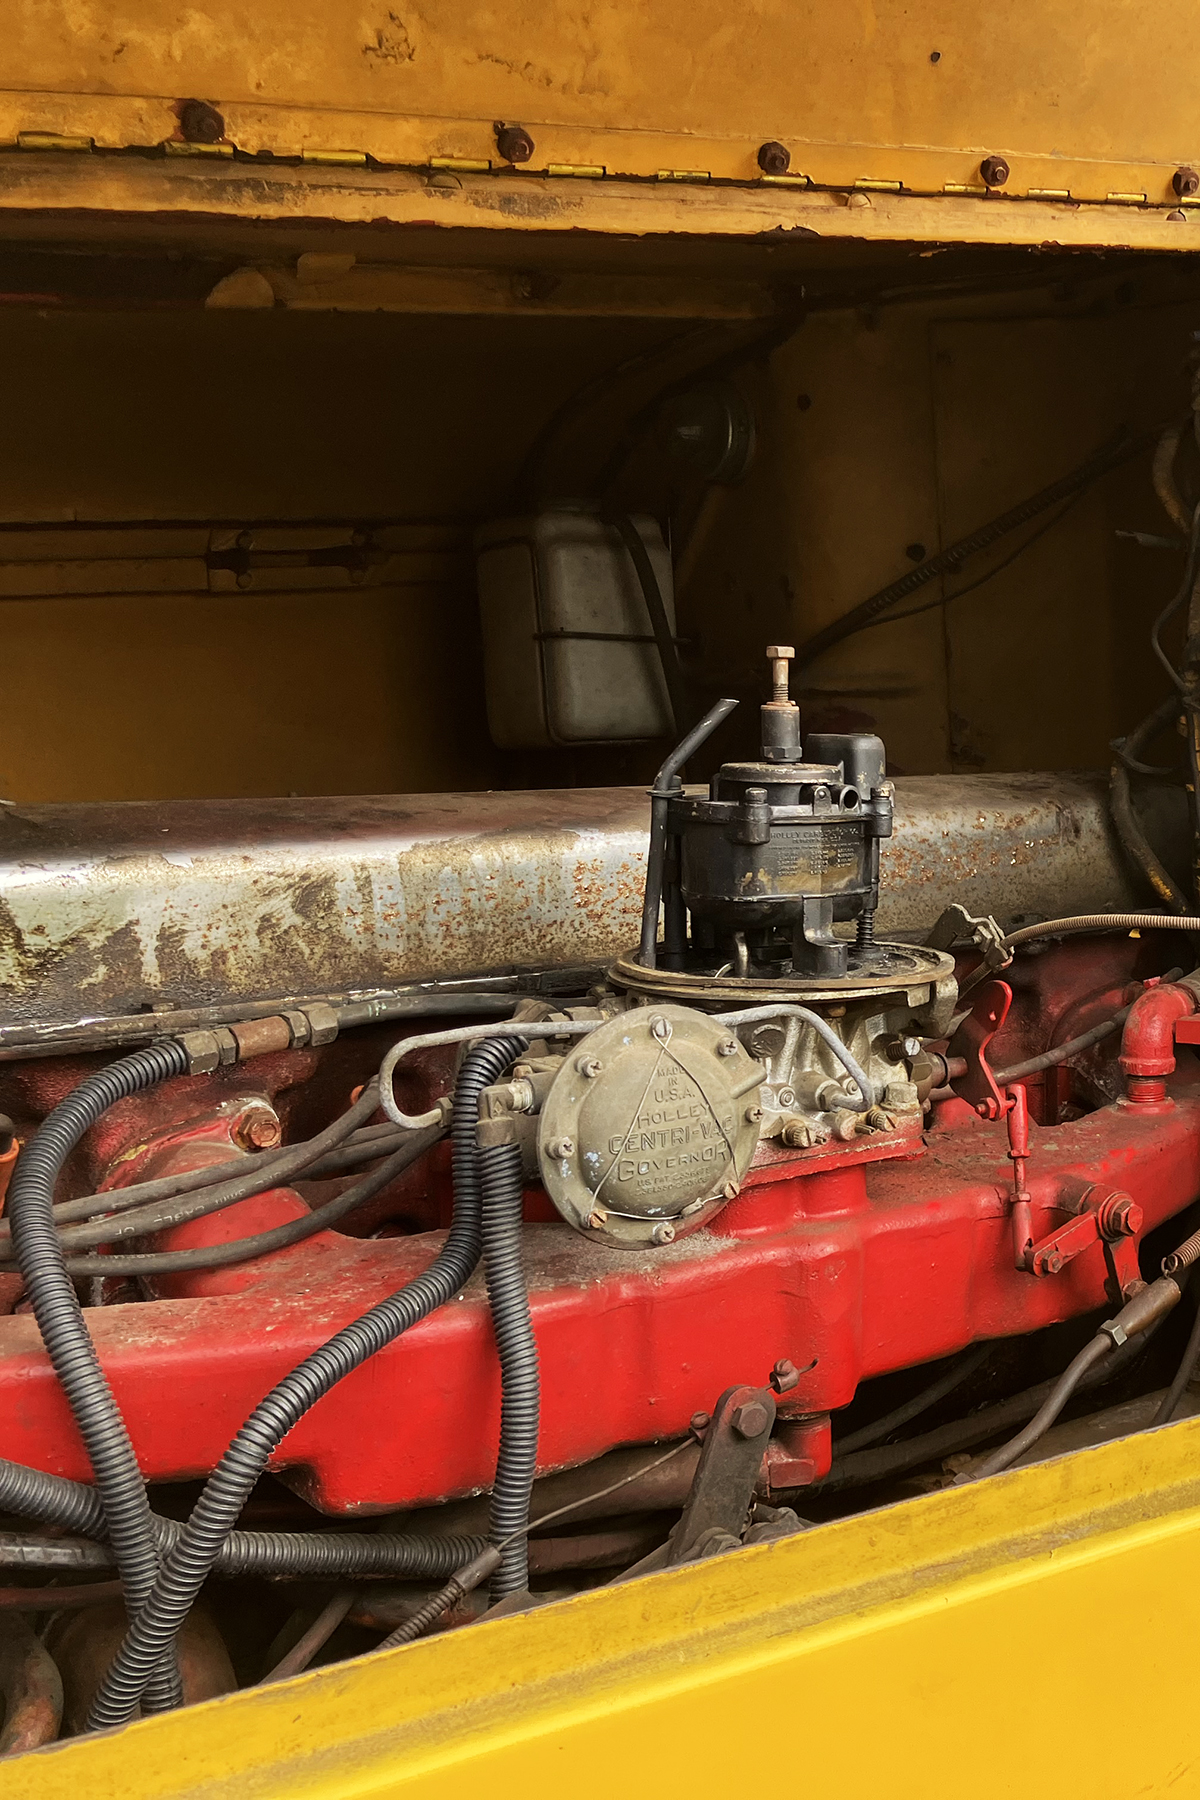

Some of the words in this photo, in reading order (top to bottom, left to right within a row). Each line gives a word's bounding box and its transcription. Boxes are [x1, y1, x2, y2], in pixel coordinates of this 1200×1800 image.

[771, 831, 800, 839] HOLLEY
[656, 1066, 687, 1077] MADE
[668, 1077, 678, 1086] IN
[637, 1103, 709, 1129] HOLLEY
[618, 1139, 729, 1182] GOVERNOR
